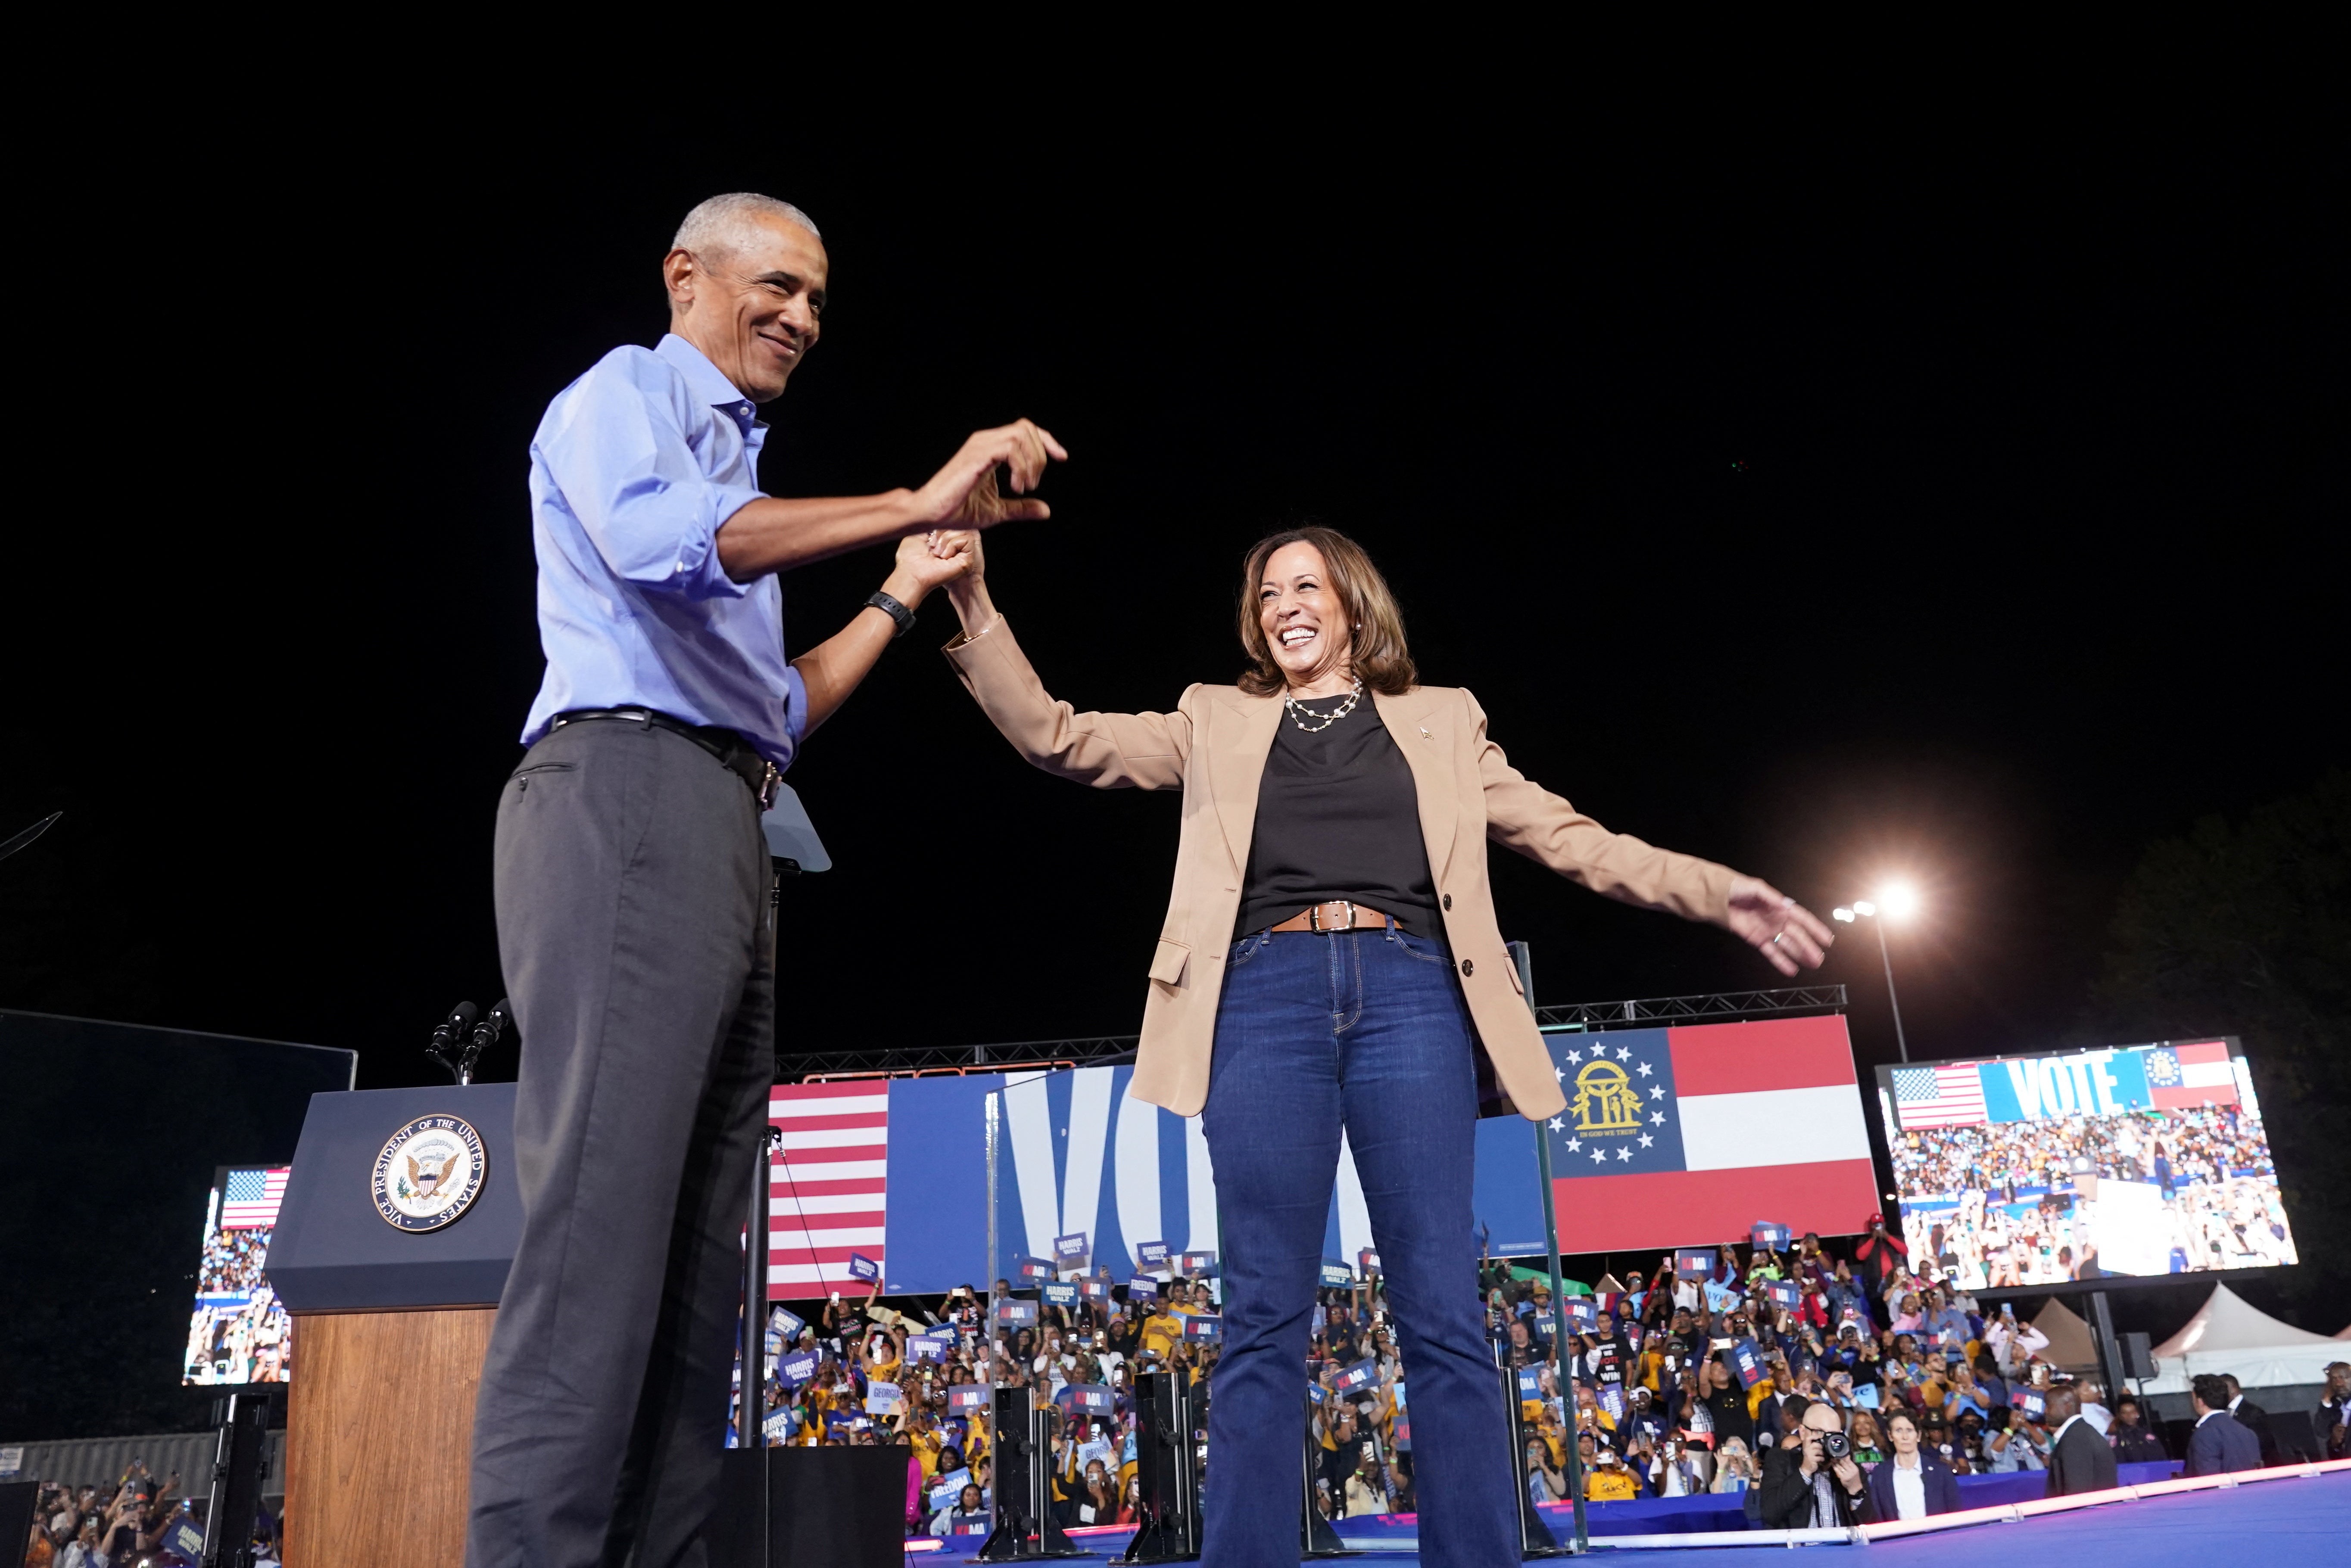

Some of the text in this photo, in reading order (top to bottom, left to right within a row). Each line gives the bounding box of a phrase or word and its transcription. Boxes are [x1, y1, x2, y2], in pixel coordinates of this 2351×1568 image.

[2005, 1052, 2125, 1121] VOTE
[376, 1119, 482, 1225] VICE PRESIDENT OF THE UNITED STATES
[1058, 1237, 1083, 1251] HARRIS
[854, 1258, 875, 1273] HARRIS
[857, 1267, 872, 1277] WALZ
[1046, 1285, 1074, 1296] HARRIS
[1131, 1279, 1157, 1293] FREEDOM
[774, 1311, 798, 1331] HARRIS
[774, 1321, 791, 1334] WALZ
[1540, 1323, 1556, 1334] VO
[914, 1341, 941, 1353] HARRIS
[784, 1358, 814, 1376] HARRIS
[1736, 1344, 1759, 1383] KAMALA
[790, 1369, 812, 1380] WALZ
[1337, 1365, 1374, 1389] KAMALA
[1600, 1372, 1621, 1381] WIN
[874, 1388, 900, 1399] GEORGIA
[952, 1391, 987, 1406] KAMALA
[1075, 1391, 1110, 1406] KAMALA
